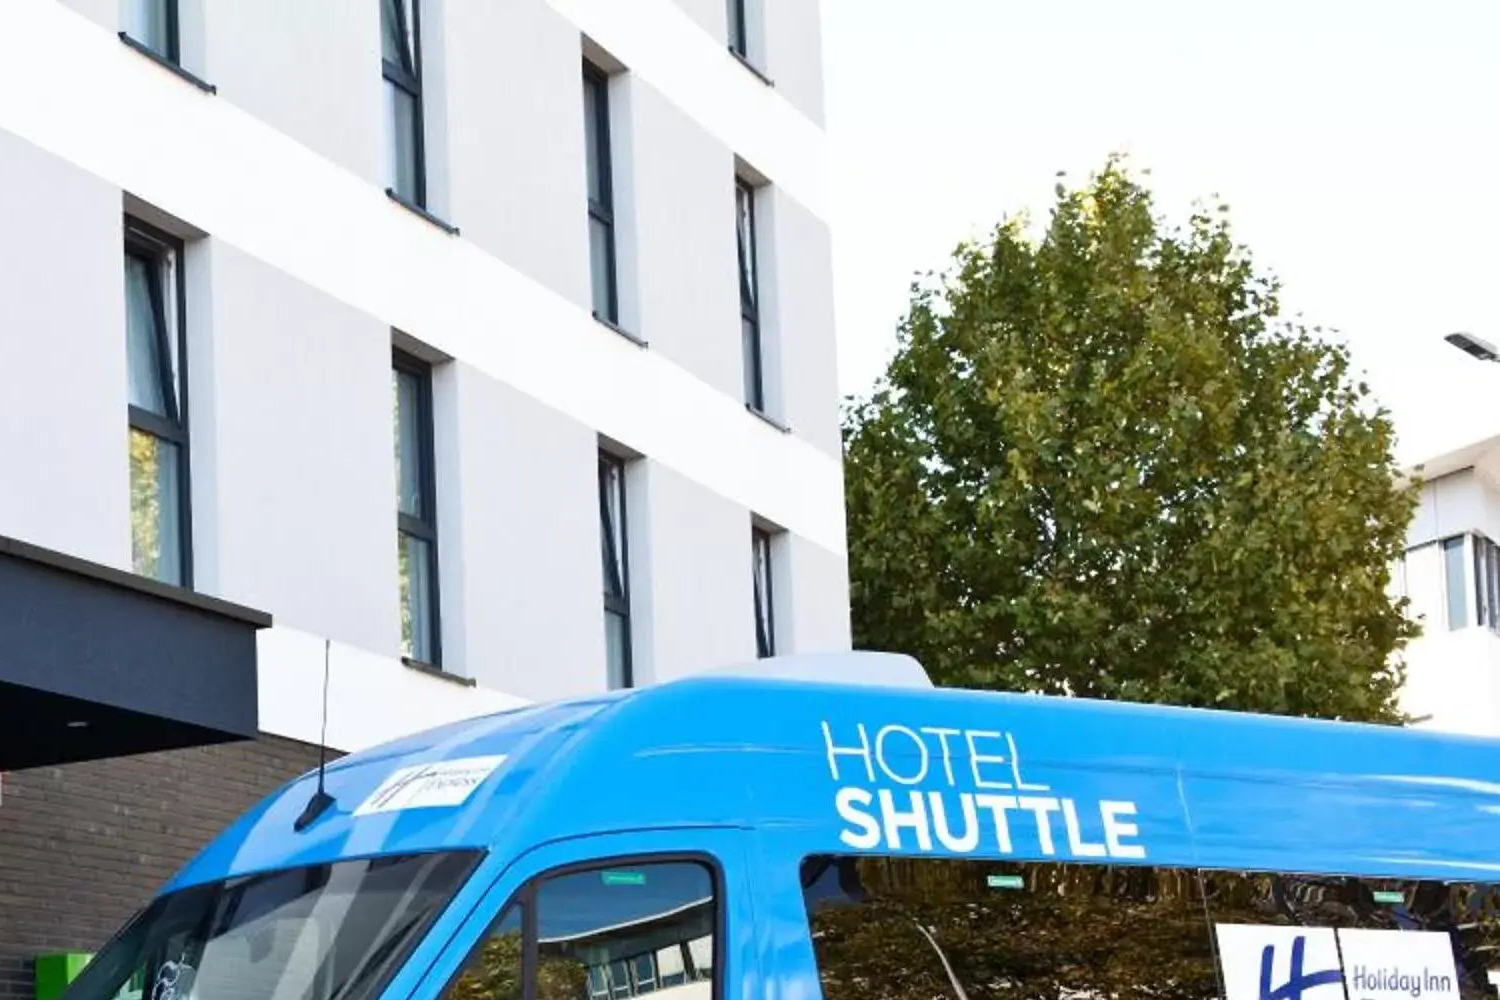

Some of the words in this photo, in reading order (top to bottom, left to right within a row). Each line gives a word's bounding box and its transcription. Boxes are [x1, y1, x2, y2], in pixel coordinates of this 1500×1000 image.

[821, 721, 1050, 791] HOTEL
[835, 787, 1147, 858] SHUTTLE
[1353, 965, 1422, 998] Holiday
[1424, 967, 1451, 992] Inn
